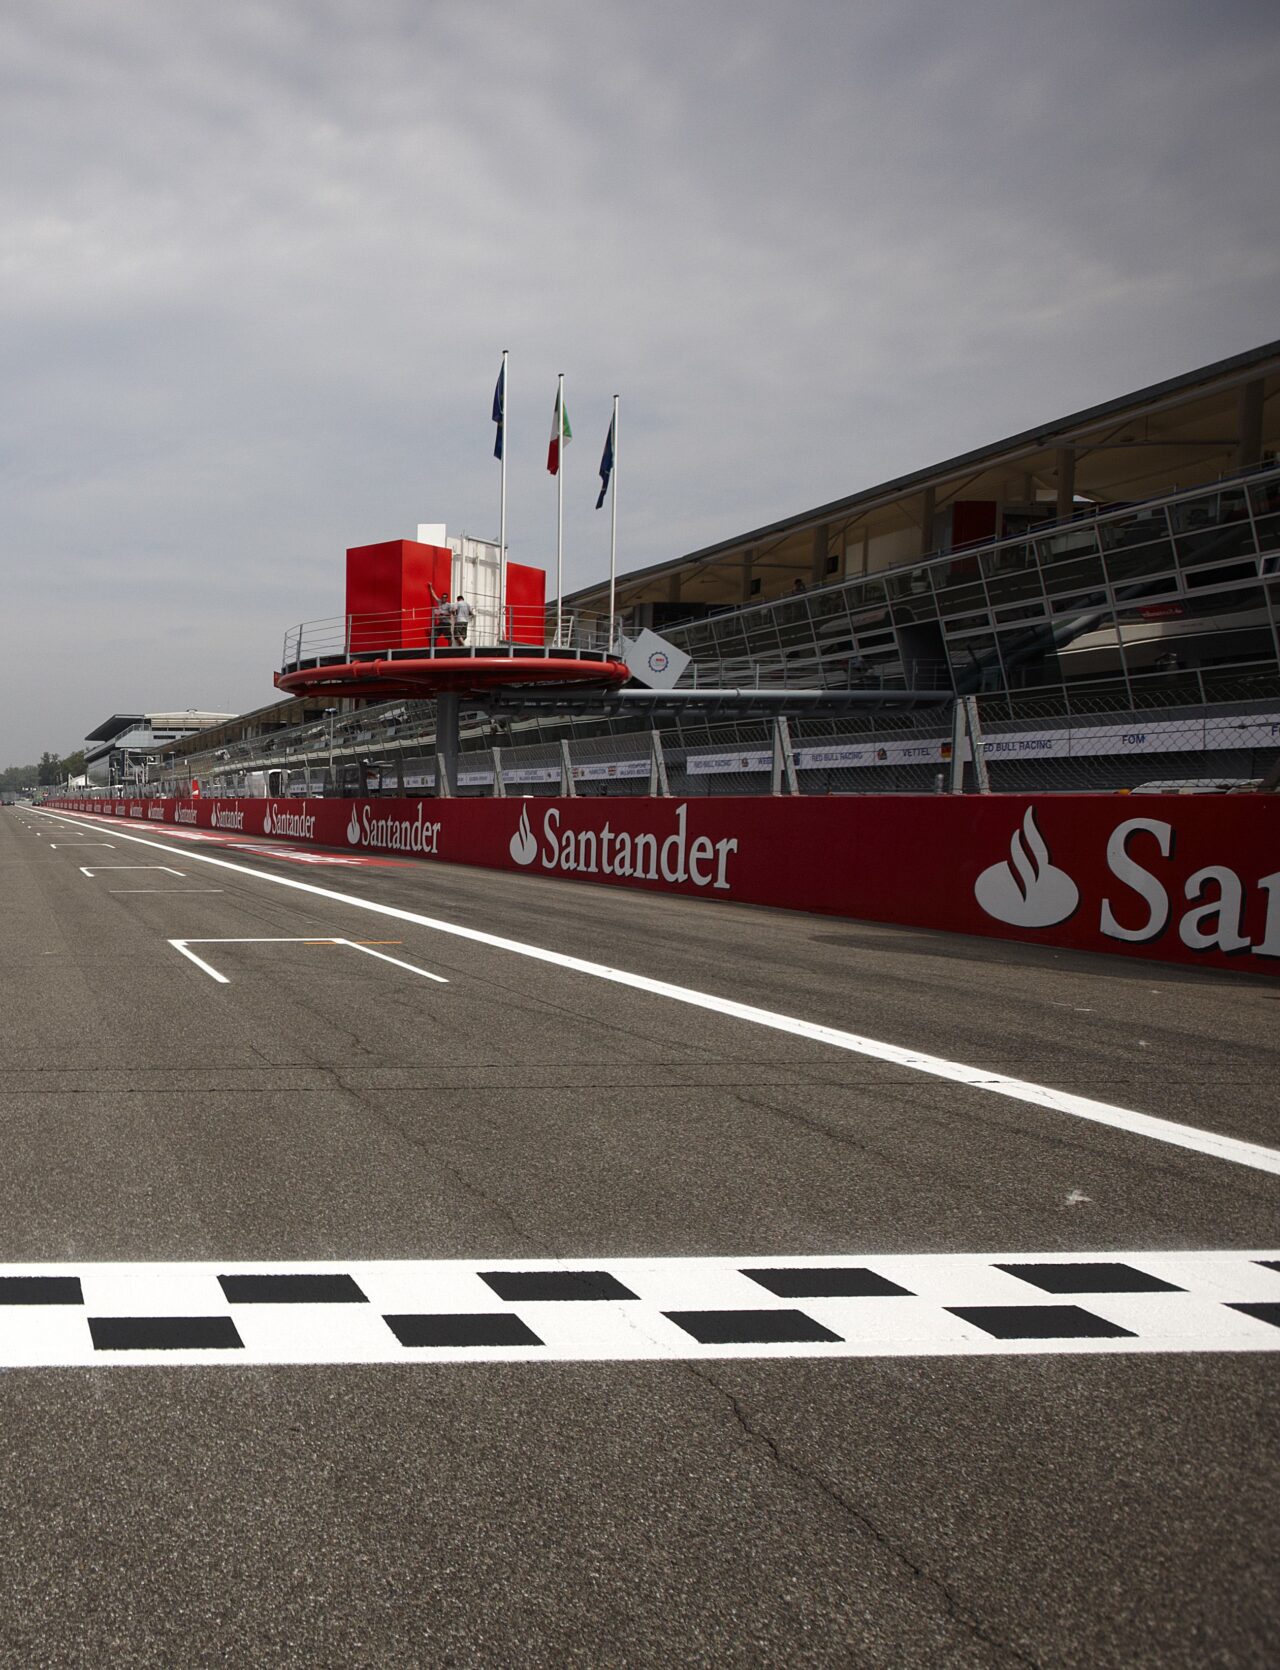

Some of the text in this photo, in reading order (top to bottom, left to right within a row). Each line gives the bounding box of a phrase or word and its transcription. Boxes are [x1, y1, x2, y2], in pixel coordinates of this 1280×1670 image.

[982, 740, 1053, 753] ED BULL RACING
[1121, 734, 1146, 745] FOM
[811, 751, 863, 763] RED BULL RACING
[902, 748, 931, 758] VETTEL
[216, 800, 244, 830] Santander
[272, 801, 316, 838] Santander
[361, 801, 441, 853] Santander
[541, 802, 738, 889] Santander
